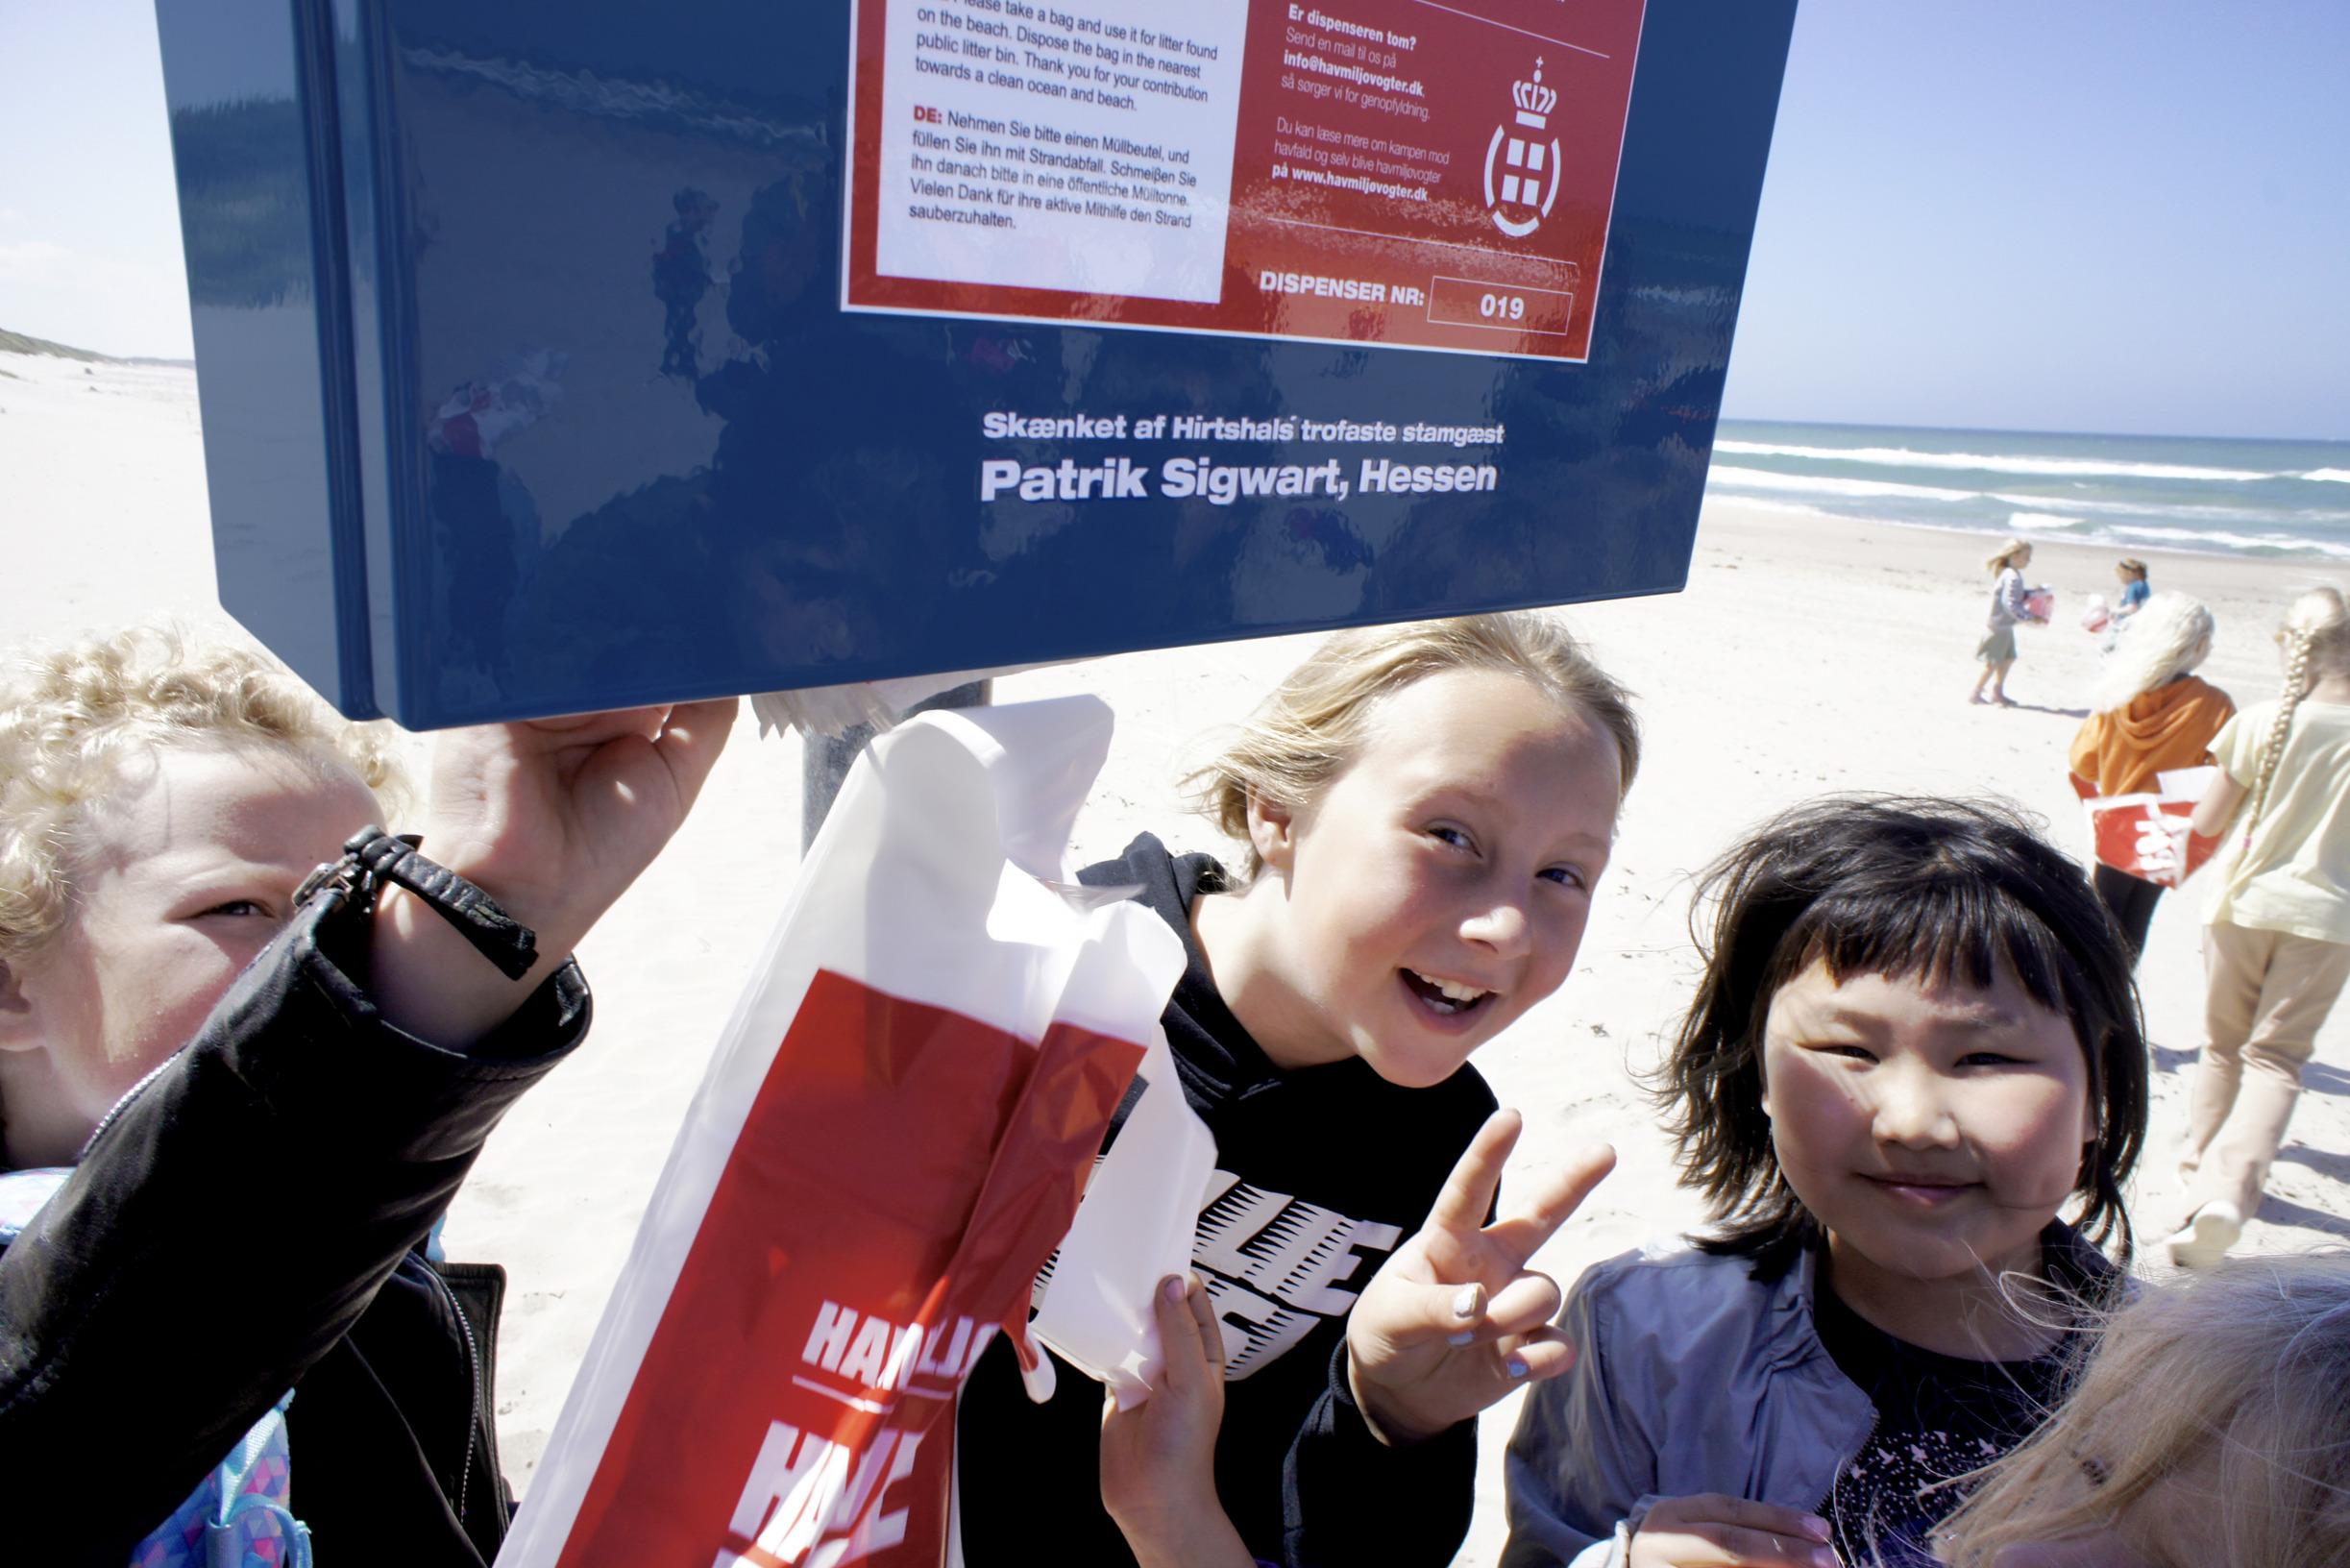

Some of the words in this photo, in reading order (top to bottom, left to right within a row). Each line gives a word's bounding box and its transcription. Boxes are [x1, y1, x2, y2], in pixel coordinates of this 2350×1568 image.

[917, 8, 936, 23] on
[940, 9, 963, 29] the
[967, 14, 1012, 39] beach.
[1016, 25, 1069, 51] Dispose
[1073, 37, 1092, 56] the
[1096, 42, 1119, 65] bag
[1122, 47, 1133, 64] in
[1136, 52, 1155, 69] the
[1158, 59, 1201, 79] nearest
[953, 0, 1001, 12] ease
[1005, 0, 1034, 19] take
[1038, 10, 1045, 22] a
[1049, 9, 1074, 32] bag
[1077, 18, 1101, 35] and
[1105, 24, 1127, 40] use
[1130, 26, 1138, 42] it
[1139, 29, 1157, 46] for
[1159, 33, 1185, 52] litter
[1186, 39, 1218, 61] found
[1285, 26, 1315, 48] Send
[1317, 37, 1332, 52] en
[1334, 41, 1356, 58] mail
[1358, 45, 1366, 61] til
[1368, 51, 1381, 64] os
[1383, 52, 1397, 69] på
[1288, 3, 1305, 21] Er
[1307, 9, 1383, 43] dispenseren
[1386, 31, 1417, 51] tom?
[916, 33, 959, 54] public
[962, 38, 992, 60] litter
[995, 44, 1018, 65] bin.
[1024, 50, 1064, 74] Thank
[1067, 63, 1090, 80] you
[1094, 65, 1111, 83] for
[1113, 72, 1139, 88] your
[1142, 79, 1209, 102] contribution
[916, 56, 971, 81] towards
[975, 70, 984, 83] a
[988, 70, 1023, 90] clean
[1027, 80, 1066, 97] ocean
[1070, 86, 1093, 103] and
[1097, 89, 1137, 111] beach.
[1281, 72, 1294, 89] så
[1297, 79, 1332, 99] sørger
[1334, 85, 1343, 100] vi
[1345, 86, 1359, 103] for
[1360, 93, 1431, 122] genopfyldning.
[913, 130, 950, 150] füllen
[955, 136, 977, 155] Sie
[981, 140, 1001, 158] ihn
[1006, 146, 1025, 161] mit
[1029, 148, 1106, 174] Strandabfall.
[1111, 160, 1175, 184] Schmeißen
[1179, 171, 1196, 187] Sie
[914, 105, 942, 125] DE:
[947, 110, 1005, 135] Nehmen
[1010, 120, 1031, 138] Sie
[1035, 124, 1061, 144] bitte
[1065, 131, 1098, 149] einen
[1102, 135, 1164, 161] Müllbeutel,
[1167, 150, 1189, 164] und
[1276, 116, 1292, 135] Du
[1295, 121, 1314, 138] kan
[1316, 125, 1342, 144] læse
[1344, 133, 1369, 149] mere
[1371, 139, 1387, 153] om
[1389, 139, 1427, 161] kampen
[1429, 150, 1450, 165] mod
[912, 154, 932, 171] ihn
[936, 158, 987, 180] danach
[991, 164, 1018, 184] bitte
[1022, 169, 1034, 185] in
[1038, 173, 1064, 189] eine
[1067, 176, 1129, 198] öffentliche
[1132, 184, 1189, 207] Mülltonne.
[1271, 161, 1288, 179] på
[1292, 167, 1429, 202] www.havmiljøvogter.dk
[1314, 150, 1329, 166] og
[1330, 151, 1350, 166] selv
[1352, 155, 1375, 171] blive
[909, 205, 1016, 230] sauberzuhalten.
[910, 177, 953, 199] Vielen
[958, 184, 993, 204] Dank
[997, 188, 1015, 206] für
[1045, 196, 1081, 213] aktive
[1086, 200, 1127, 220] Mithilfe
[1130, 207, 1152, 223] den
[1155, 209, 1192, 229] Strand
[1260, 270, 1385, 303] DISPENSER
[1390, 284, 1425, 307] NR:
[1480, 293, 1525, 320] 019
[982, 411, 1128, 440] Skænket
[1133, 415, 1166, 440] af
[1300, 417, 1397, 443] trofaste
[1401, 422, 1505, 448] stamgæst
[980, 456, 1149, 502] Patrik
[1160, 455, 1349, 505] Sigwart,
[1358, 458, 1498, 493] Hessen
